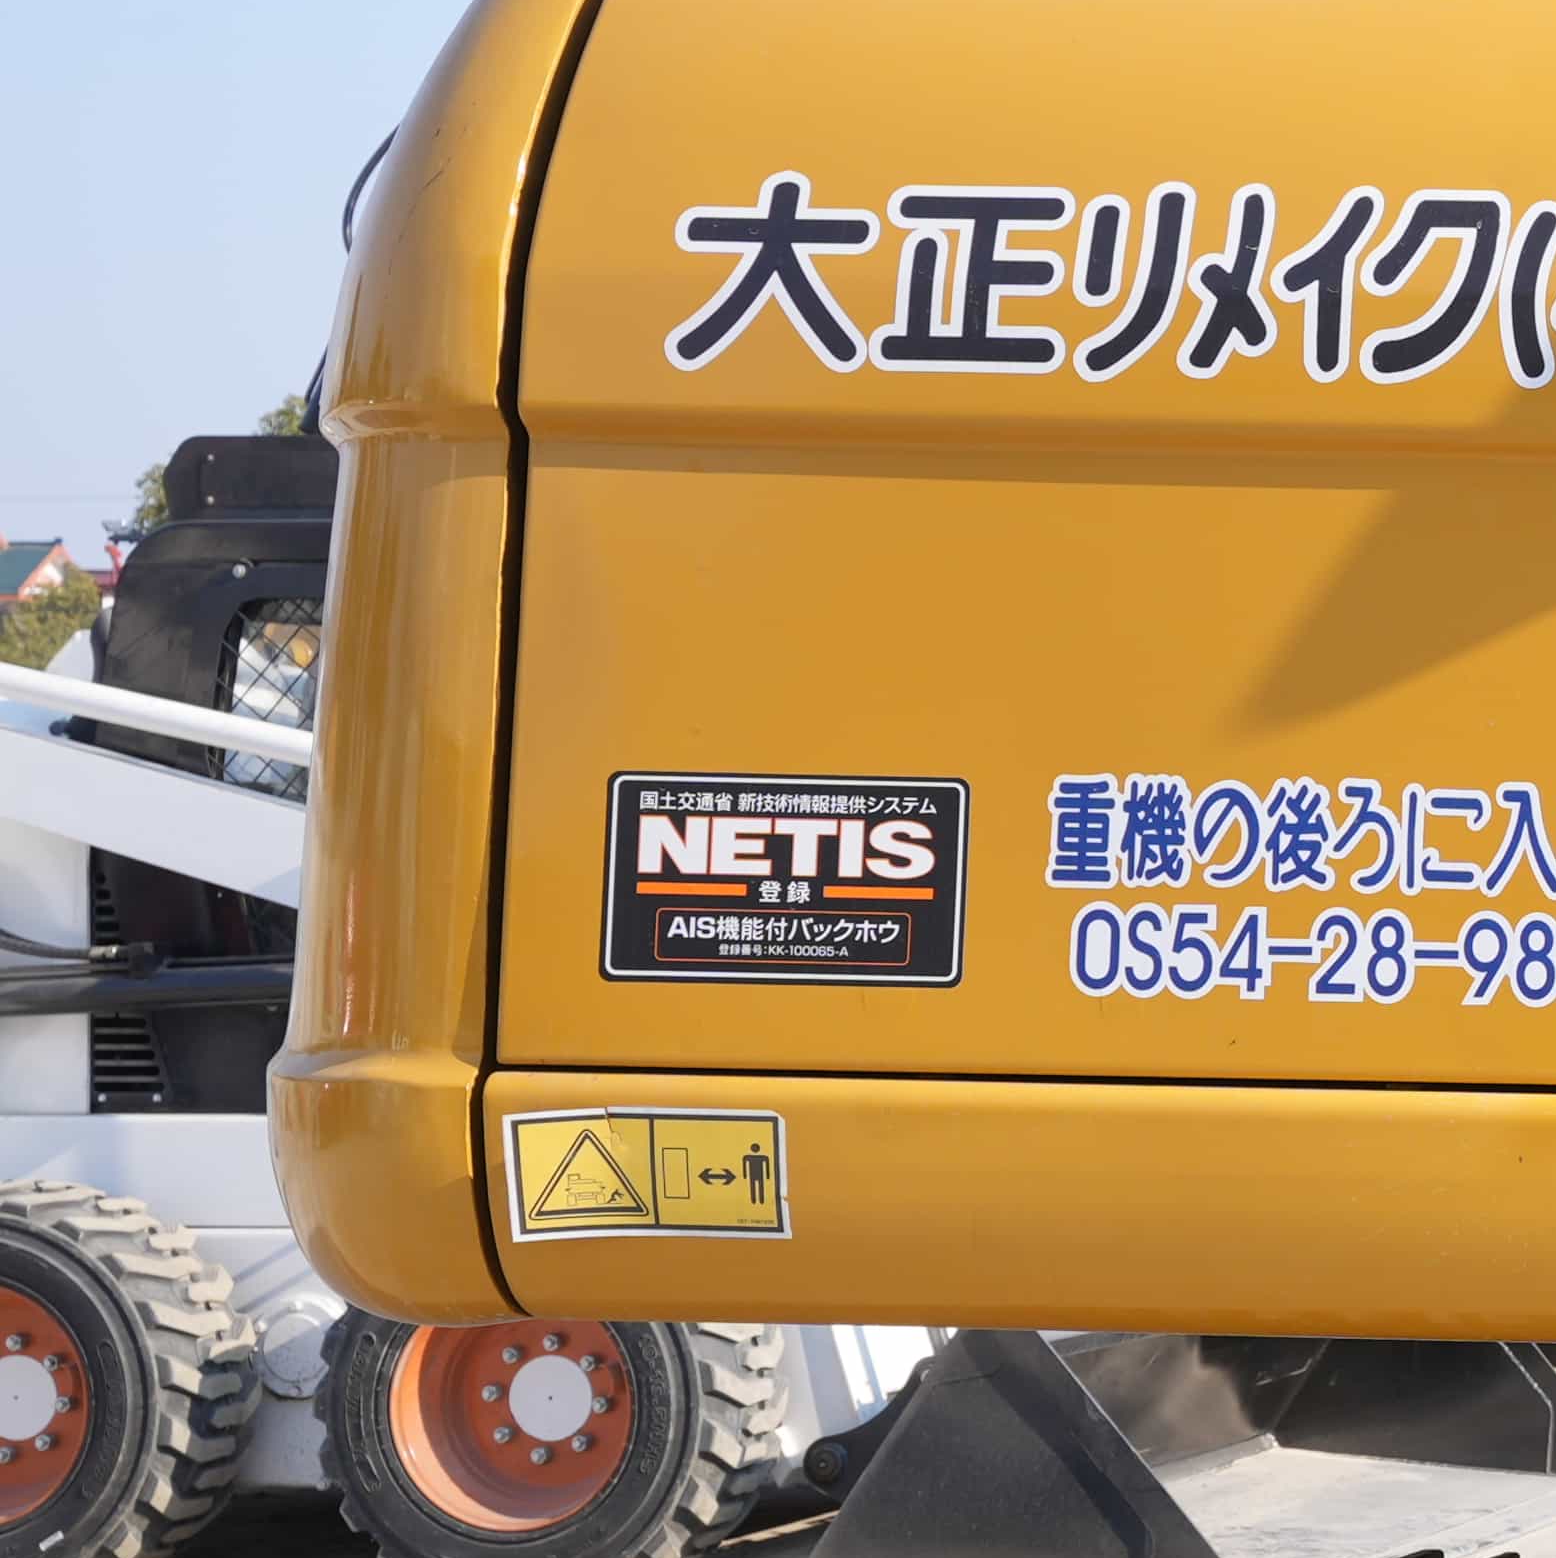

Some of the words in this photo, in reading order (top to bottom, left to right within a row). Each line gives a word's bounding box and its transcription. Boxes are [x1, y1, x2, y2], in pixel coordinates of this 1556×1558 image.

[640, 791, 733, 812] 国土交通省
[737, 793, 937, 815] 新技術情報提供システム
[636, 814, 936, 880] NETIS
[758, 880, 810, 904] 登録
[667, 916, 900, 943] AIS機能付バックホウ
